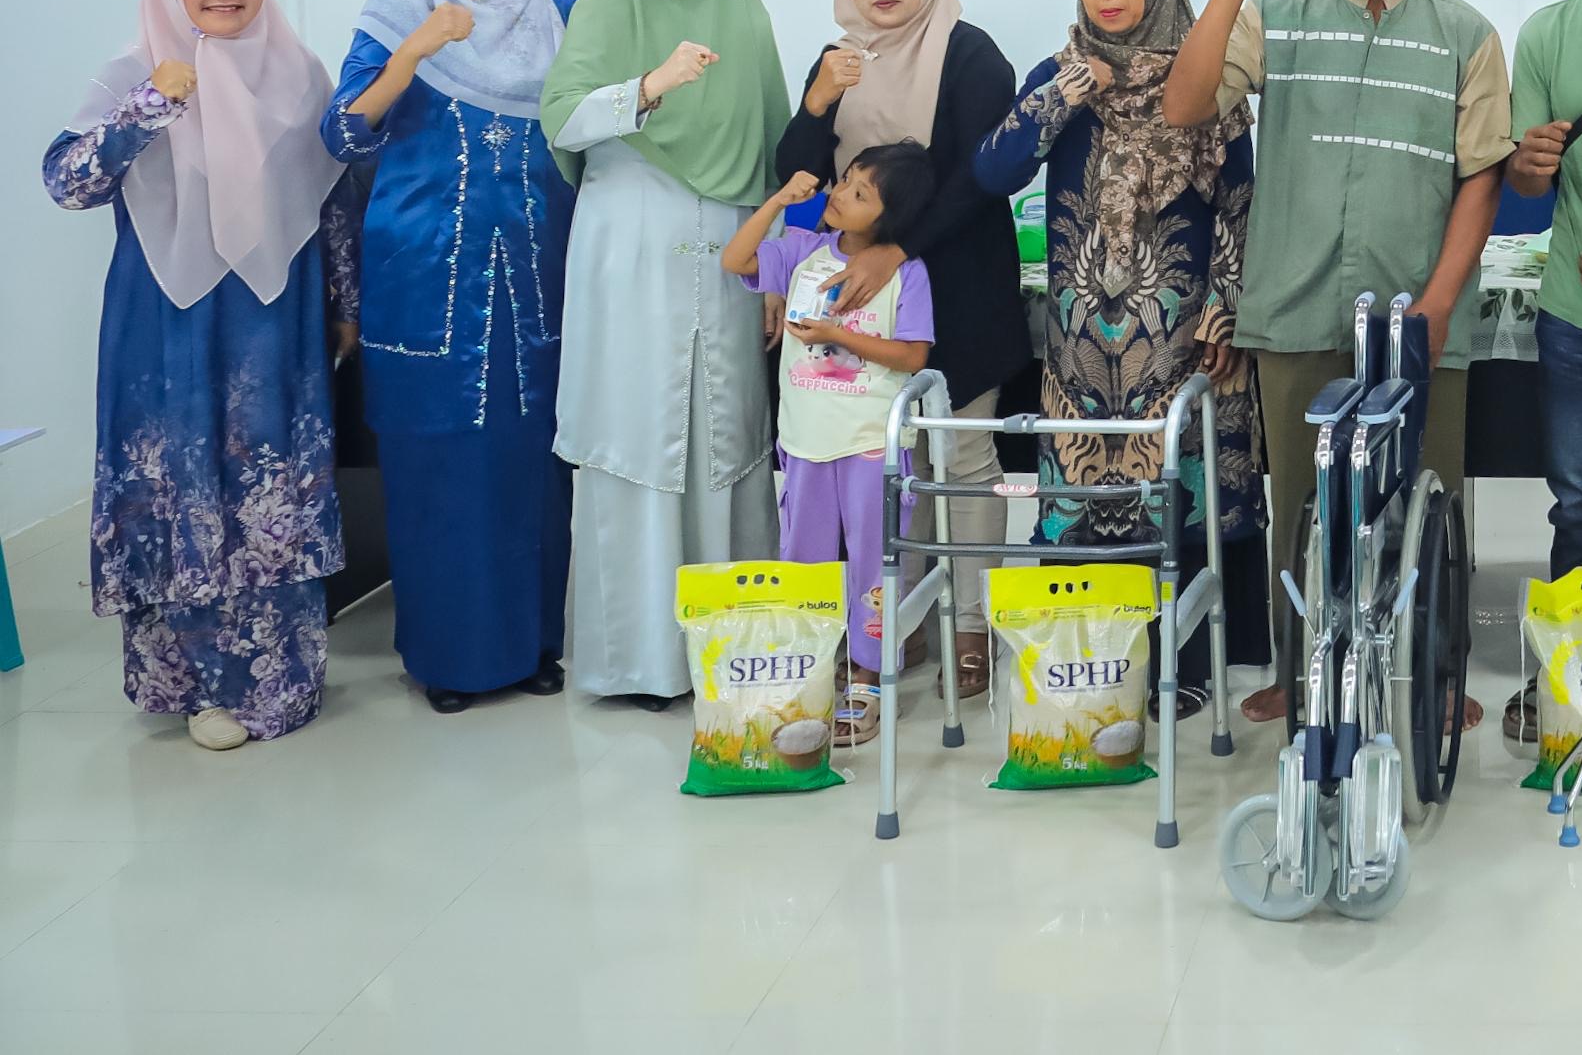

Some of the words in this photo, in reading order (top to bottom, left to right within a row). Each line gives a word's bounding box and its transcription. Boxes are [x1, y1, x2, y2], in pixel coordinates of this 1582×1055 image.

[806, 601, 838, 611] bulog
[729, 654, 816, 683] SPHP
[1047, 658, 1131, 688] SPHP
[743, 756, 754, 770] 5
[1062, 757, 1073, 771] 5
